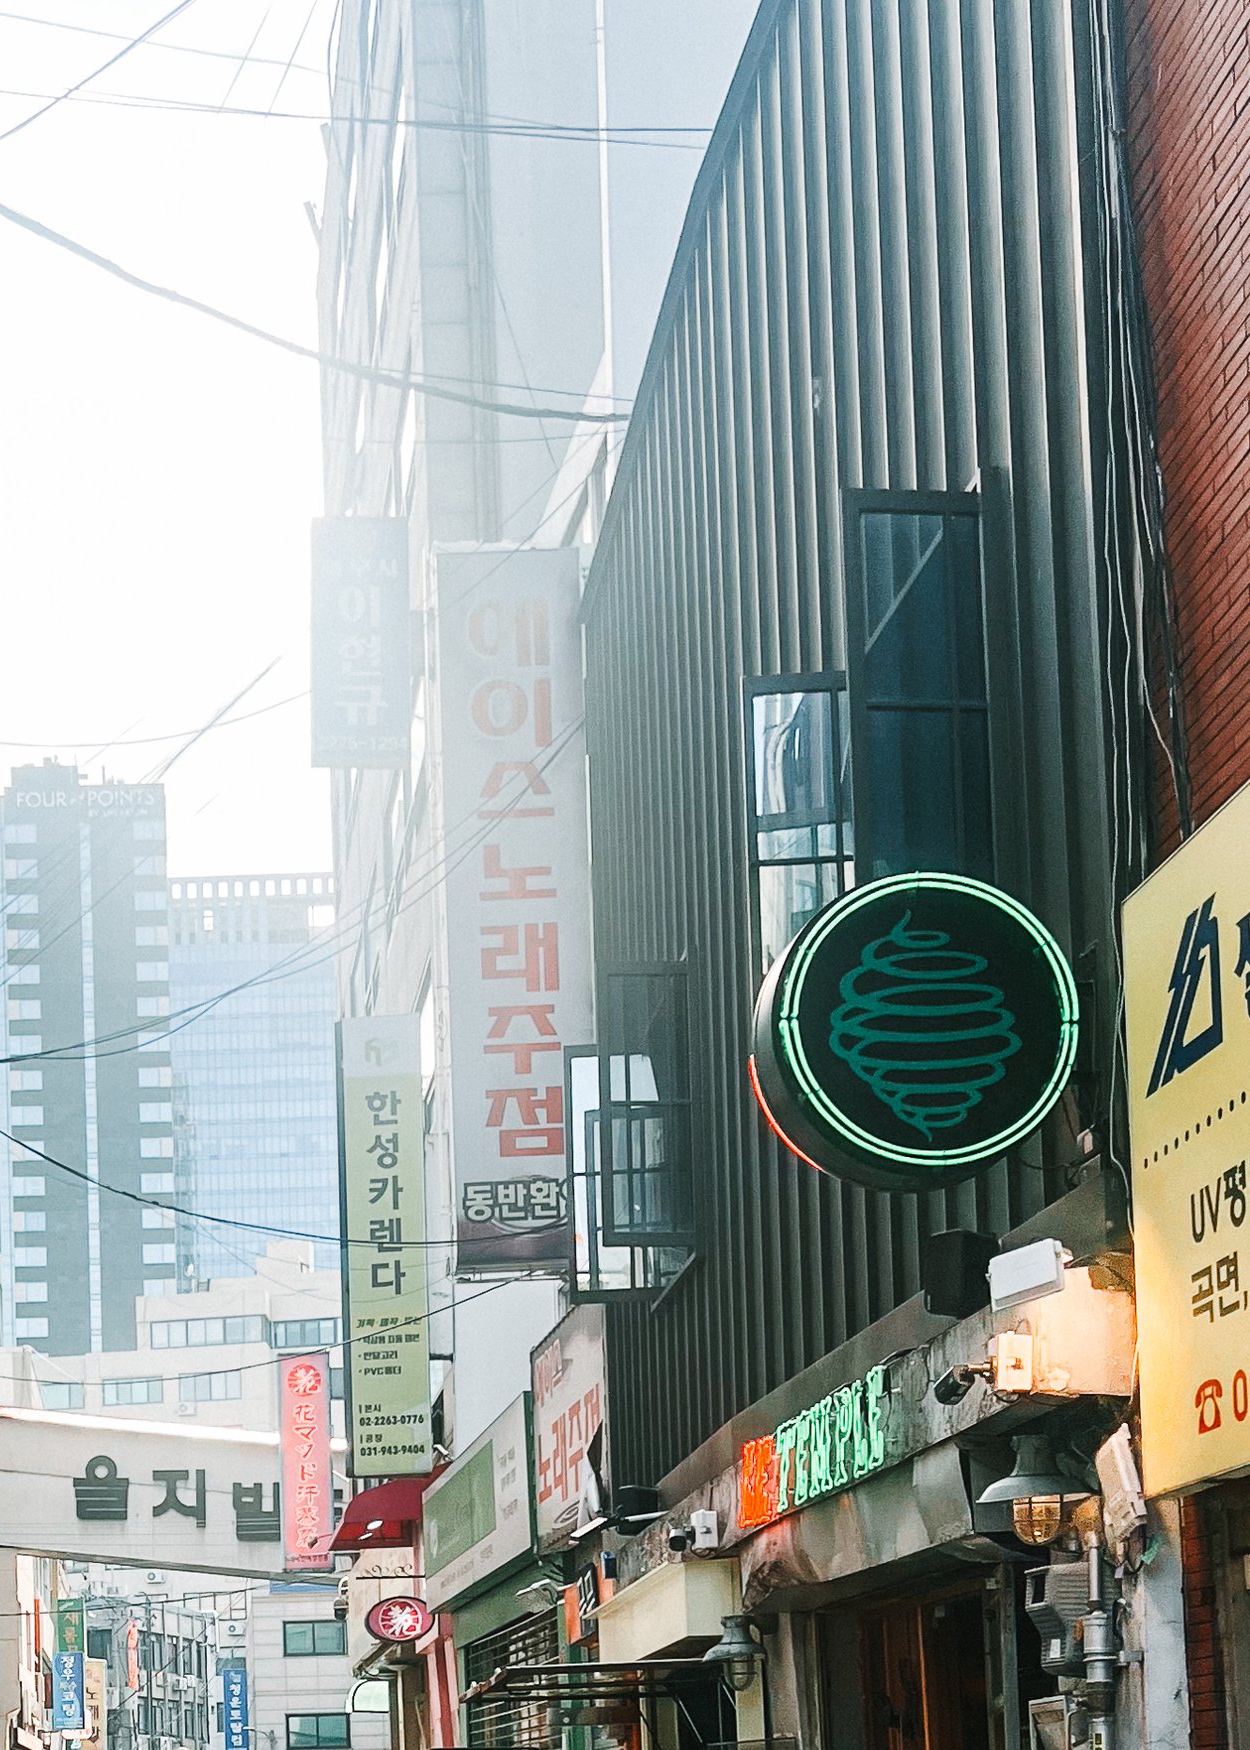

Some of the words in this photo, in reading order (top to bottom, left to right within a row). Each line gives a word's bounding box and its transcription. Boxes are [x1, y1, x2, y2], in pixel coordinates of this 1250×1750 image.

[16, 791, 68, 808] FOUR
[87, 789, 155, 807] POINTS
[468, 597, 565, 1160] 에이스노래주점
[364, 1090, 406, 1296] 한성카렌다
[359, 1414, 425, 1428] 02-2263-0776
[359, 1444, 426, 1458] 031-943-9404
[775, 1364, 886, 1514] TEMPLE
